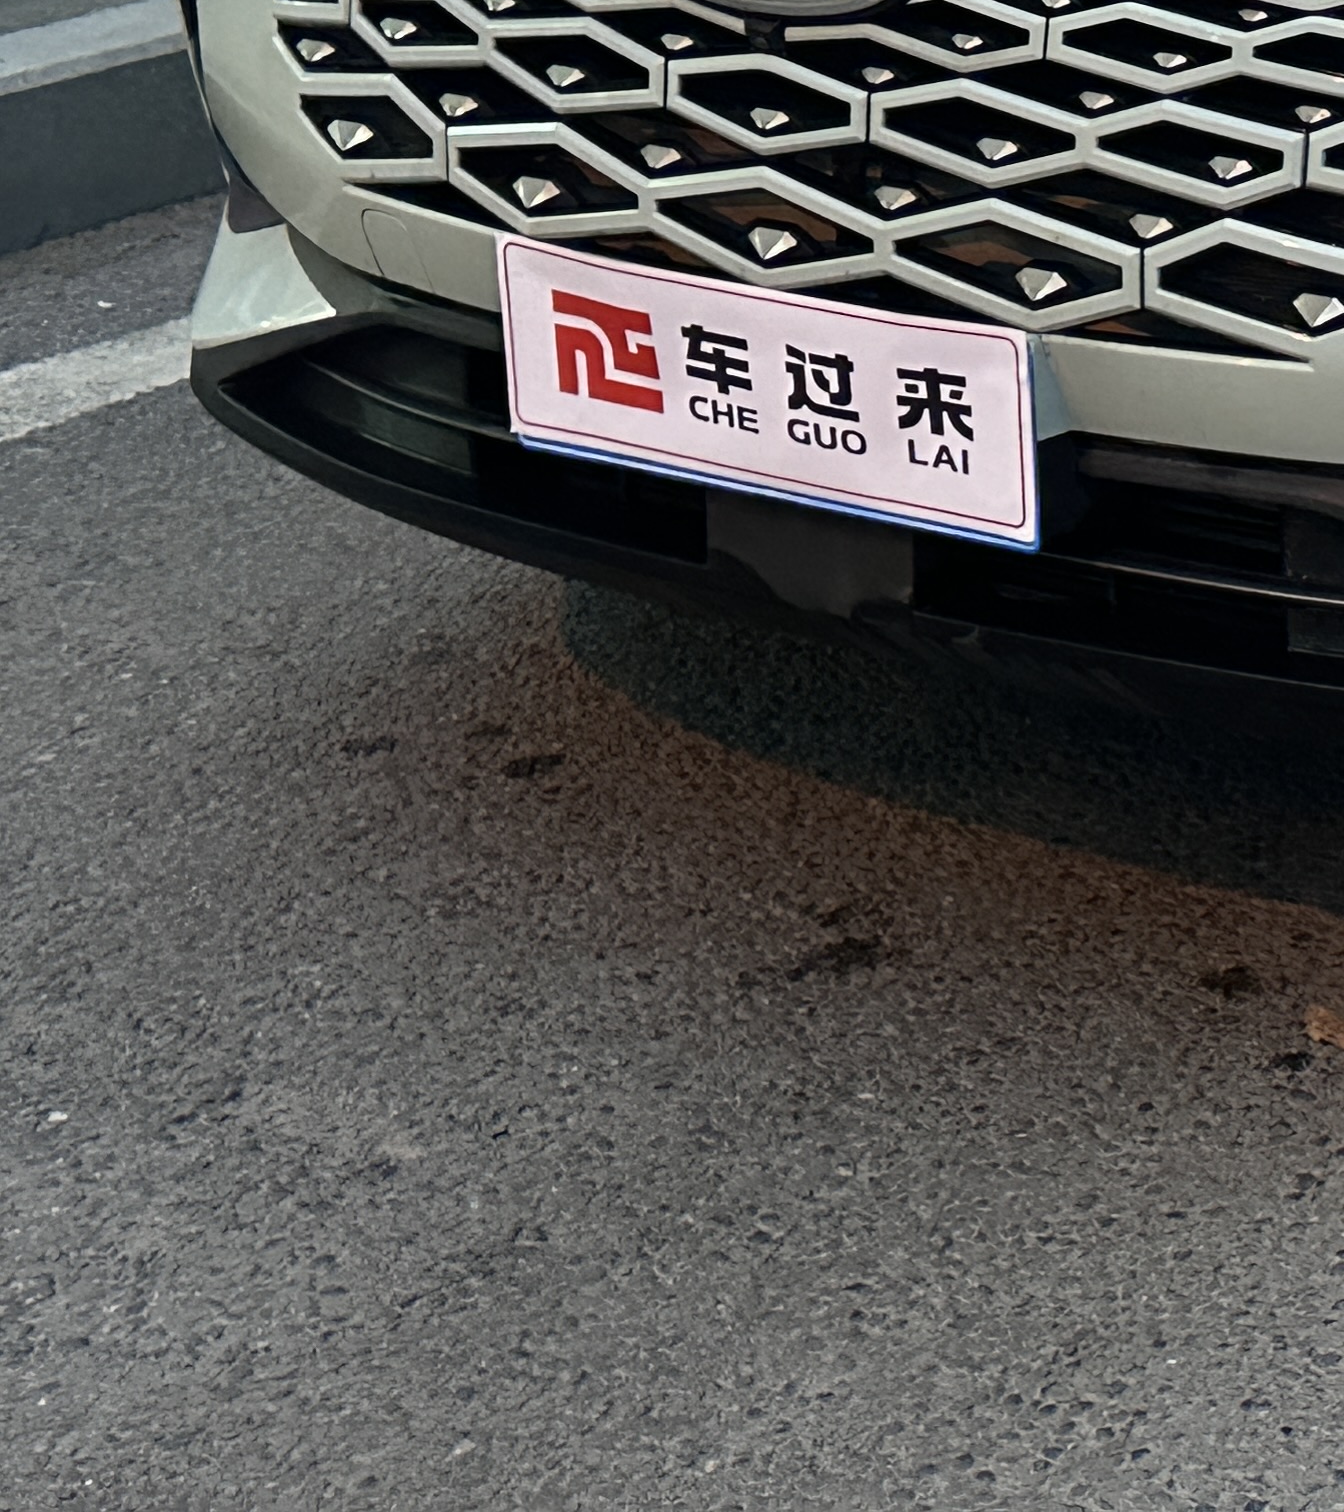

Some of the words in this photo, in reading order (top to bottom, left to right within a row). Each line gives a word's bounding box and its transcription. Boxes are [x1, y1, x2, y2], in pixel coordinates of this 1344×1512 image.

[680, 323, 974, 442] 车过来
[688, 395, 760, 435] CHE
[787, 418, 867, 455] GUO
[907, 438, 969, 475] LAI
